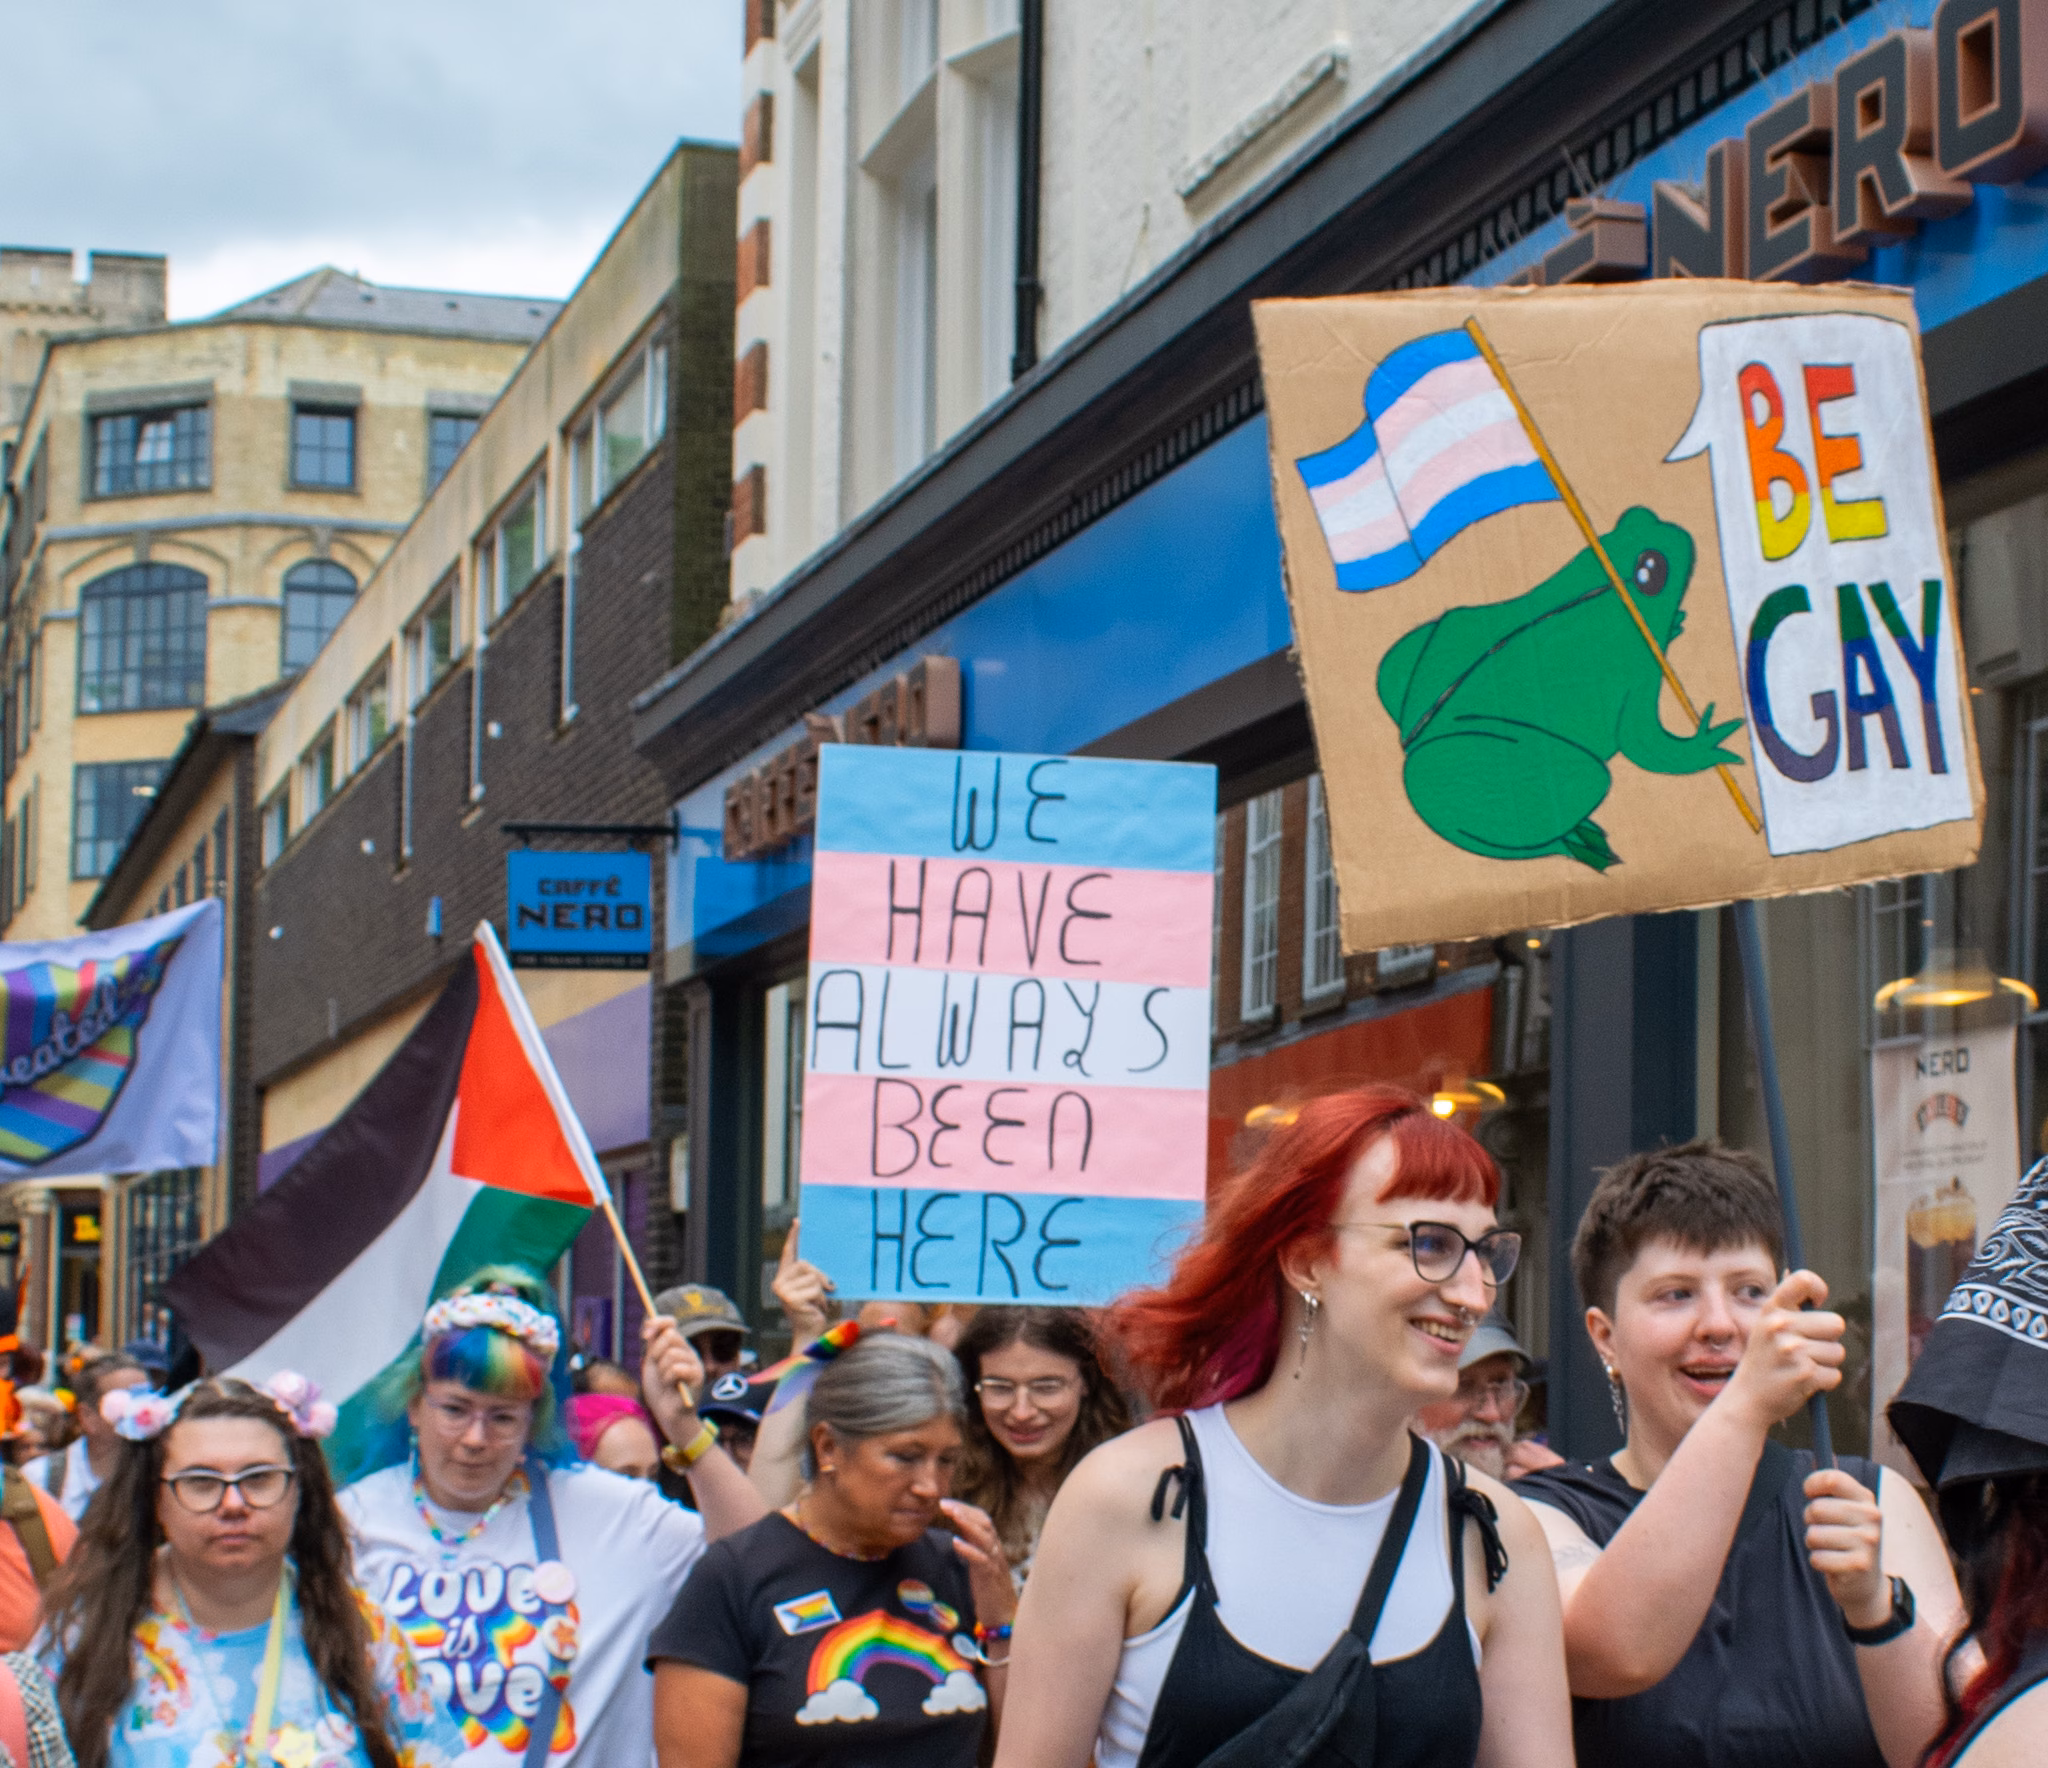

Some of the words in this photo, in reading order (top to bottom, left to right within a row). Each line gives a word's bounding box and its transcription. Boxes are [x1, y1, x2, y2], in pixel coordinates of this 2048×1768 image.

[1653, 0, 2026, 281] NERO
[1738, 360, 1889, 562] BE
[1746, 579, 1949, 784] GAY
[952, 756, 1068, 852] WE
[518, 903, 643, 930] NERO
[887, 859, 1112, 970] HAVE
[811, 969, 1170, 1078] ALWAYS
[871, 1078, 1093, 1178] BEEN
[870, 1188, 1084, 1298] HERE
[443, 1613, 480, 1660] is
